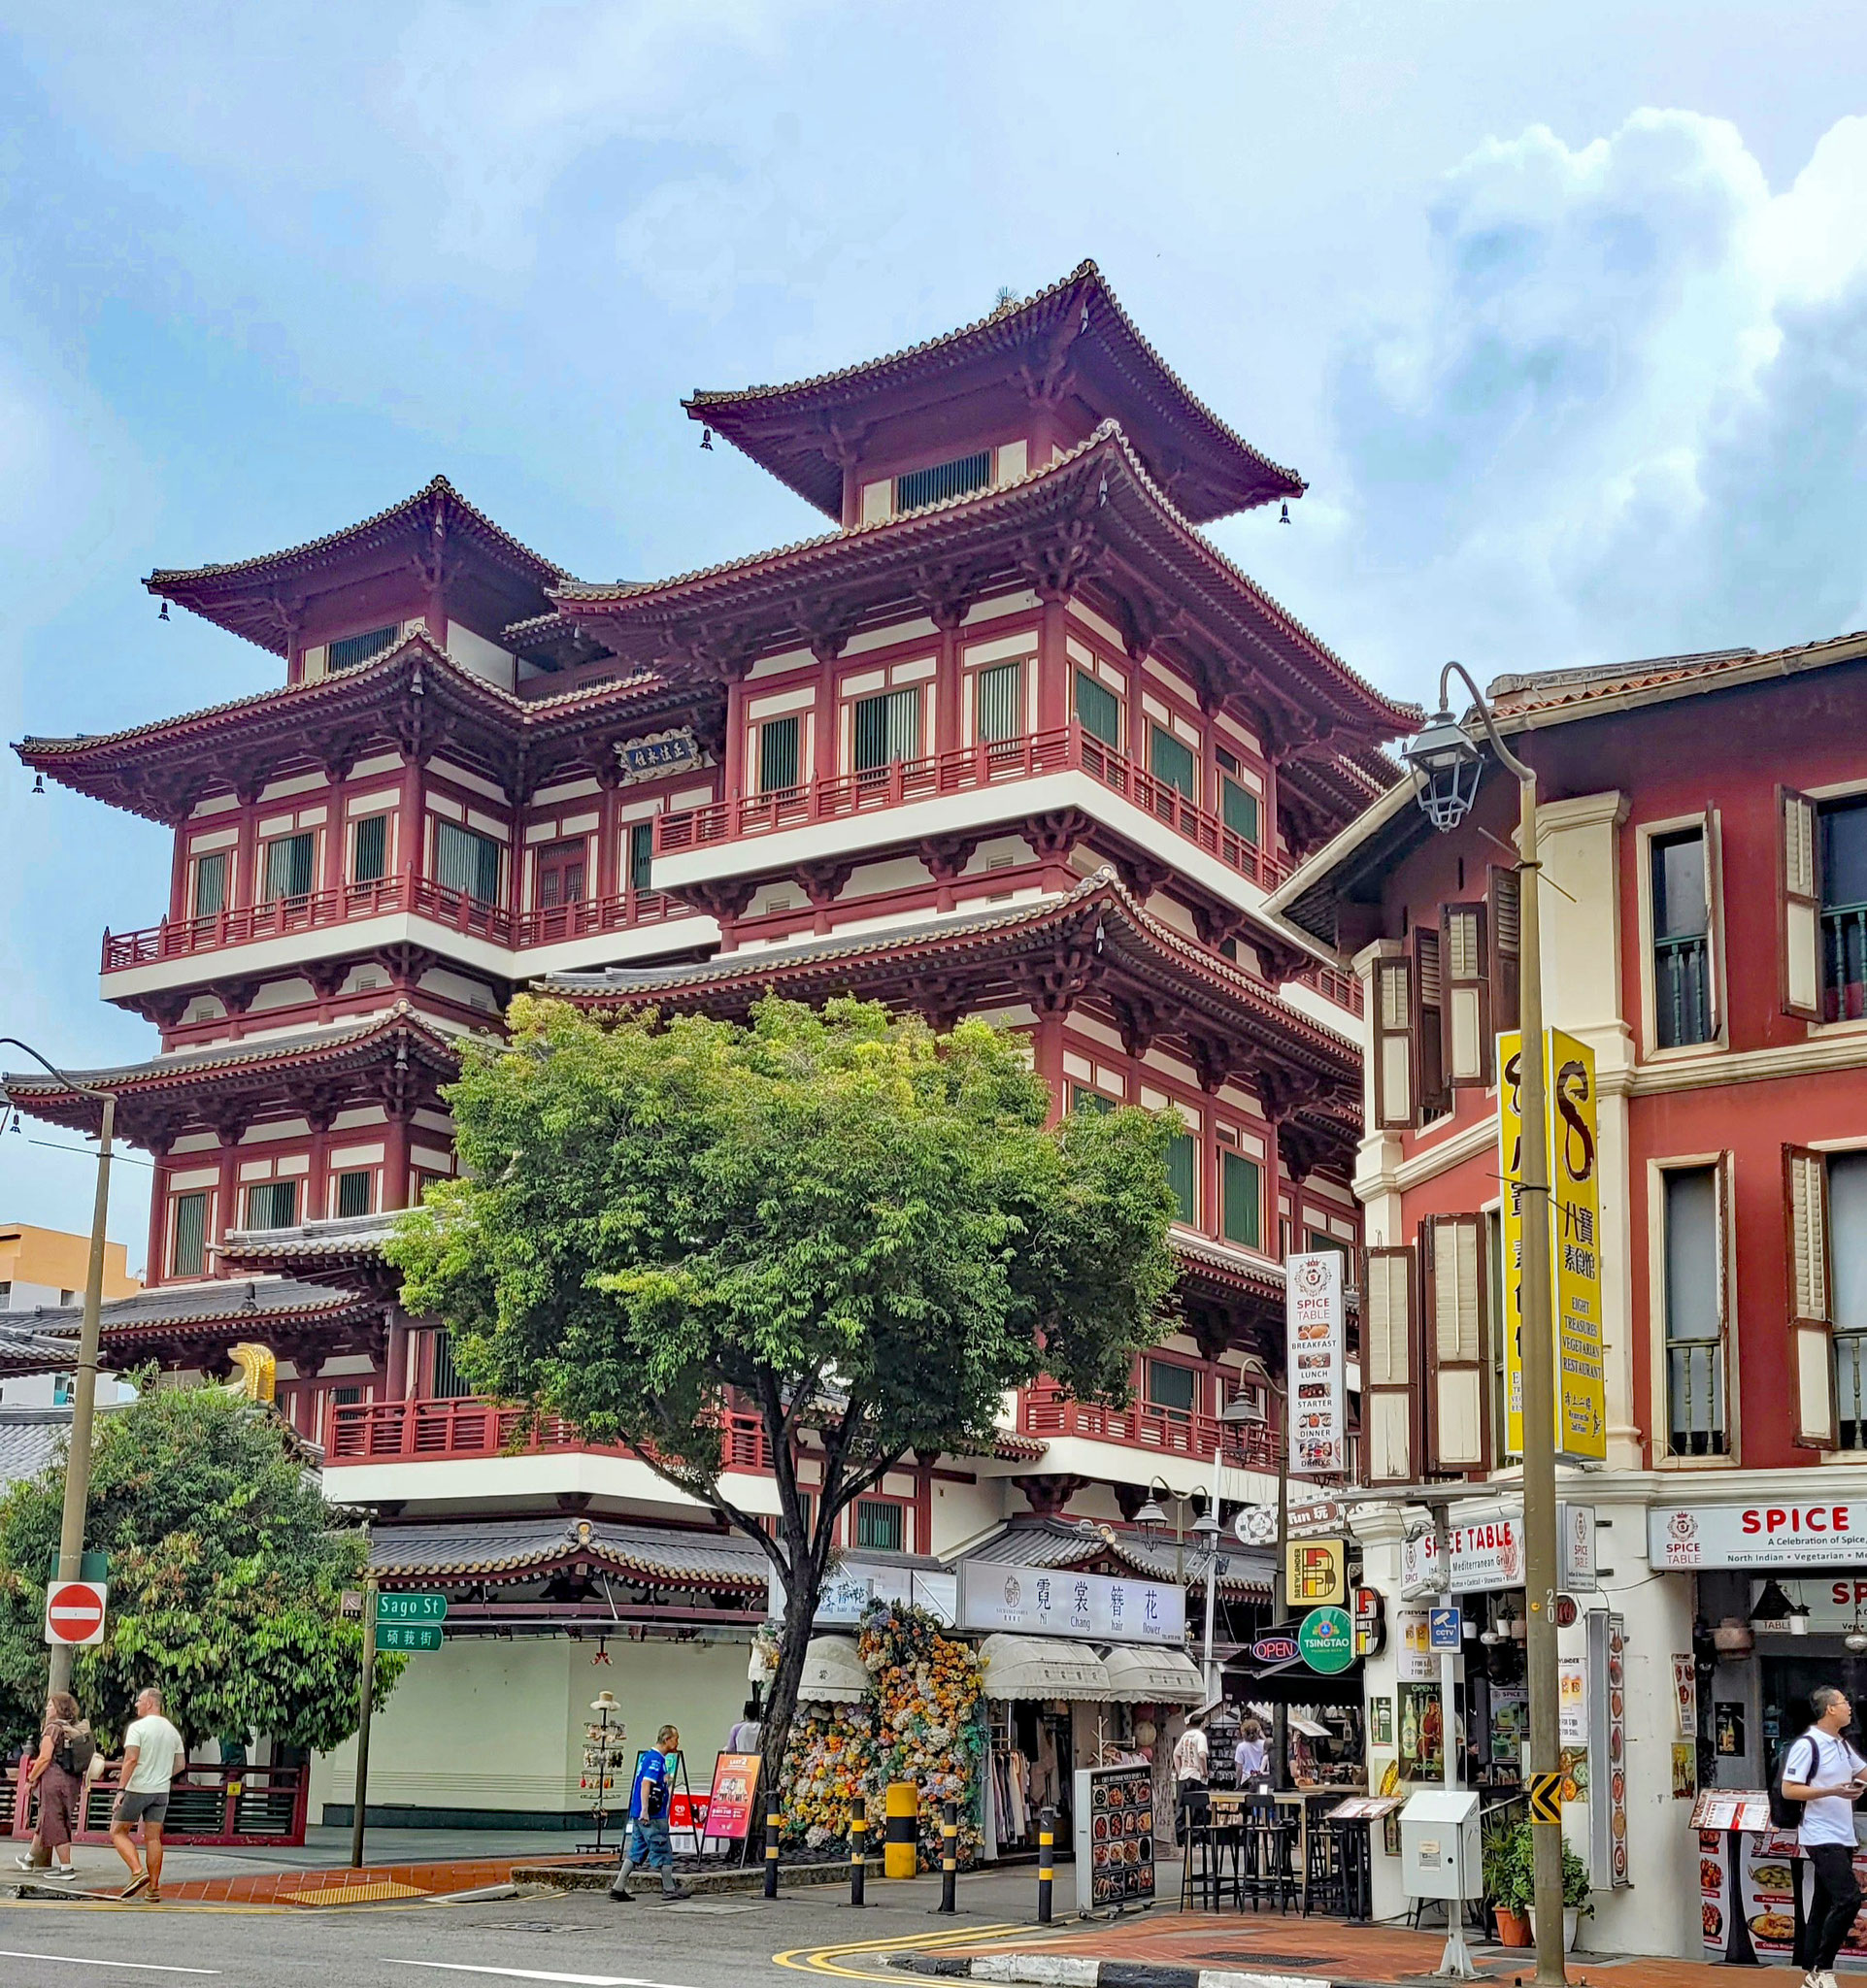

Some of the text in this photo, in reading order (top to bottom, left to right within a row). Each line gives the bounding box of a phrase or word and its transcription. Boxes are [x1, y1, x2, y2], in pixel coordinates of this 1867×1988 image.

[1297, 1298, 1330, 1309] SPICE
[1572, 1297, 1589, 1313] EIGHT
[1297, 1309, 1330, 1320] TABLE
[1564, 1315, 1597, 1338] TREASURES
[1292, 1340, 1337, 1350] BREAKFAST
[1562, 1336, 1600, 1358] VEGETARIAN
[1563, 1357, 1602, 1380] RESTAURANT
[1301, 1371, 1328, 1379] LUNCH
[1297, 1400, 1332, 1408] STARTER
[1300, 1429, 1331, 1438] DINNER
[1301, 1458, 1331, 1468] DRINKS
[1287, 1506, 1328, 1525] Fun 玩
[1742, 1507, 1850, 1534] SPICE
[1467, 1521, 1513, 1552] TABLE
[1777, 1536, 1827, 1545] Celebration
[1830, 1536, 1840, 1544] of
[1575, 1544, 1588, 1556] SPICE
[1666, 1542, 1701, 1553] SPICE
[1575, 1556, 1588, 1569] TABLE
[1666, 1553, 1702, 1565] TABLE
[1727, 1553, 1752, 1562] North
[1755, 1552, 1784, 1562] Indian
[1794, 1552, 1844, 1562] Vegetarian
[1452, 1558, 1494, 1573] Mediterranean
[1405, 1573, 1417, 1583] SPICE
[381, 1597, 439, 1617] Sago St
[1040, 1613, 1161, 1636] Ni Chang hair flower
[1304, 1638, 1350, 1648] TSINGTAO
[1255, 1641, 1293, 1658] OPEN
